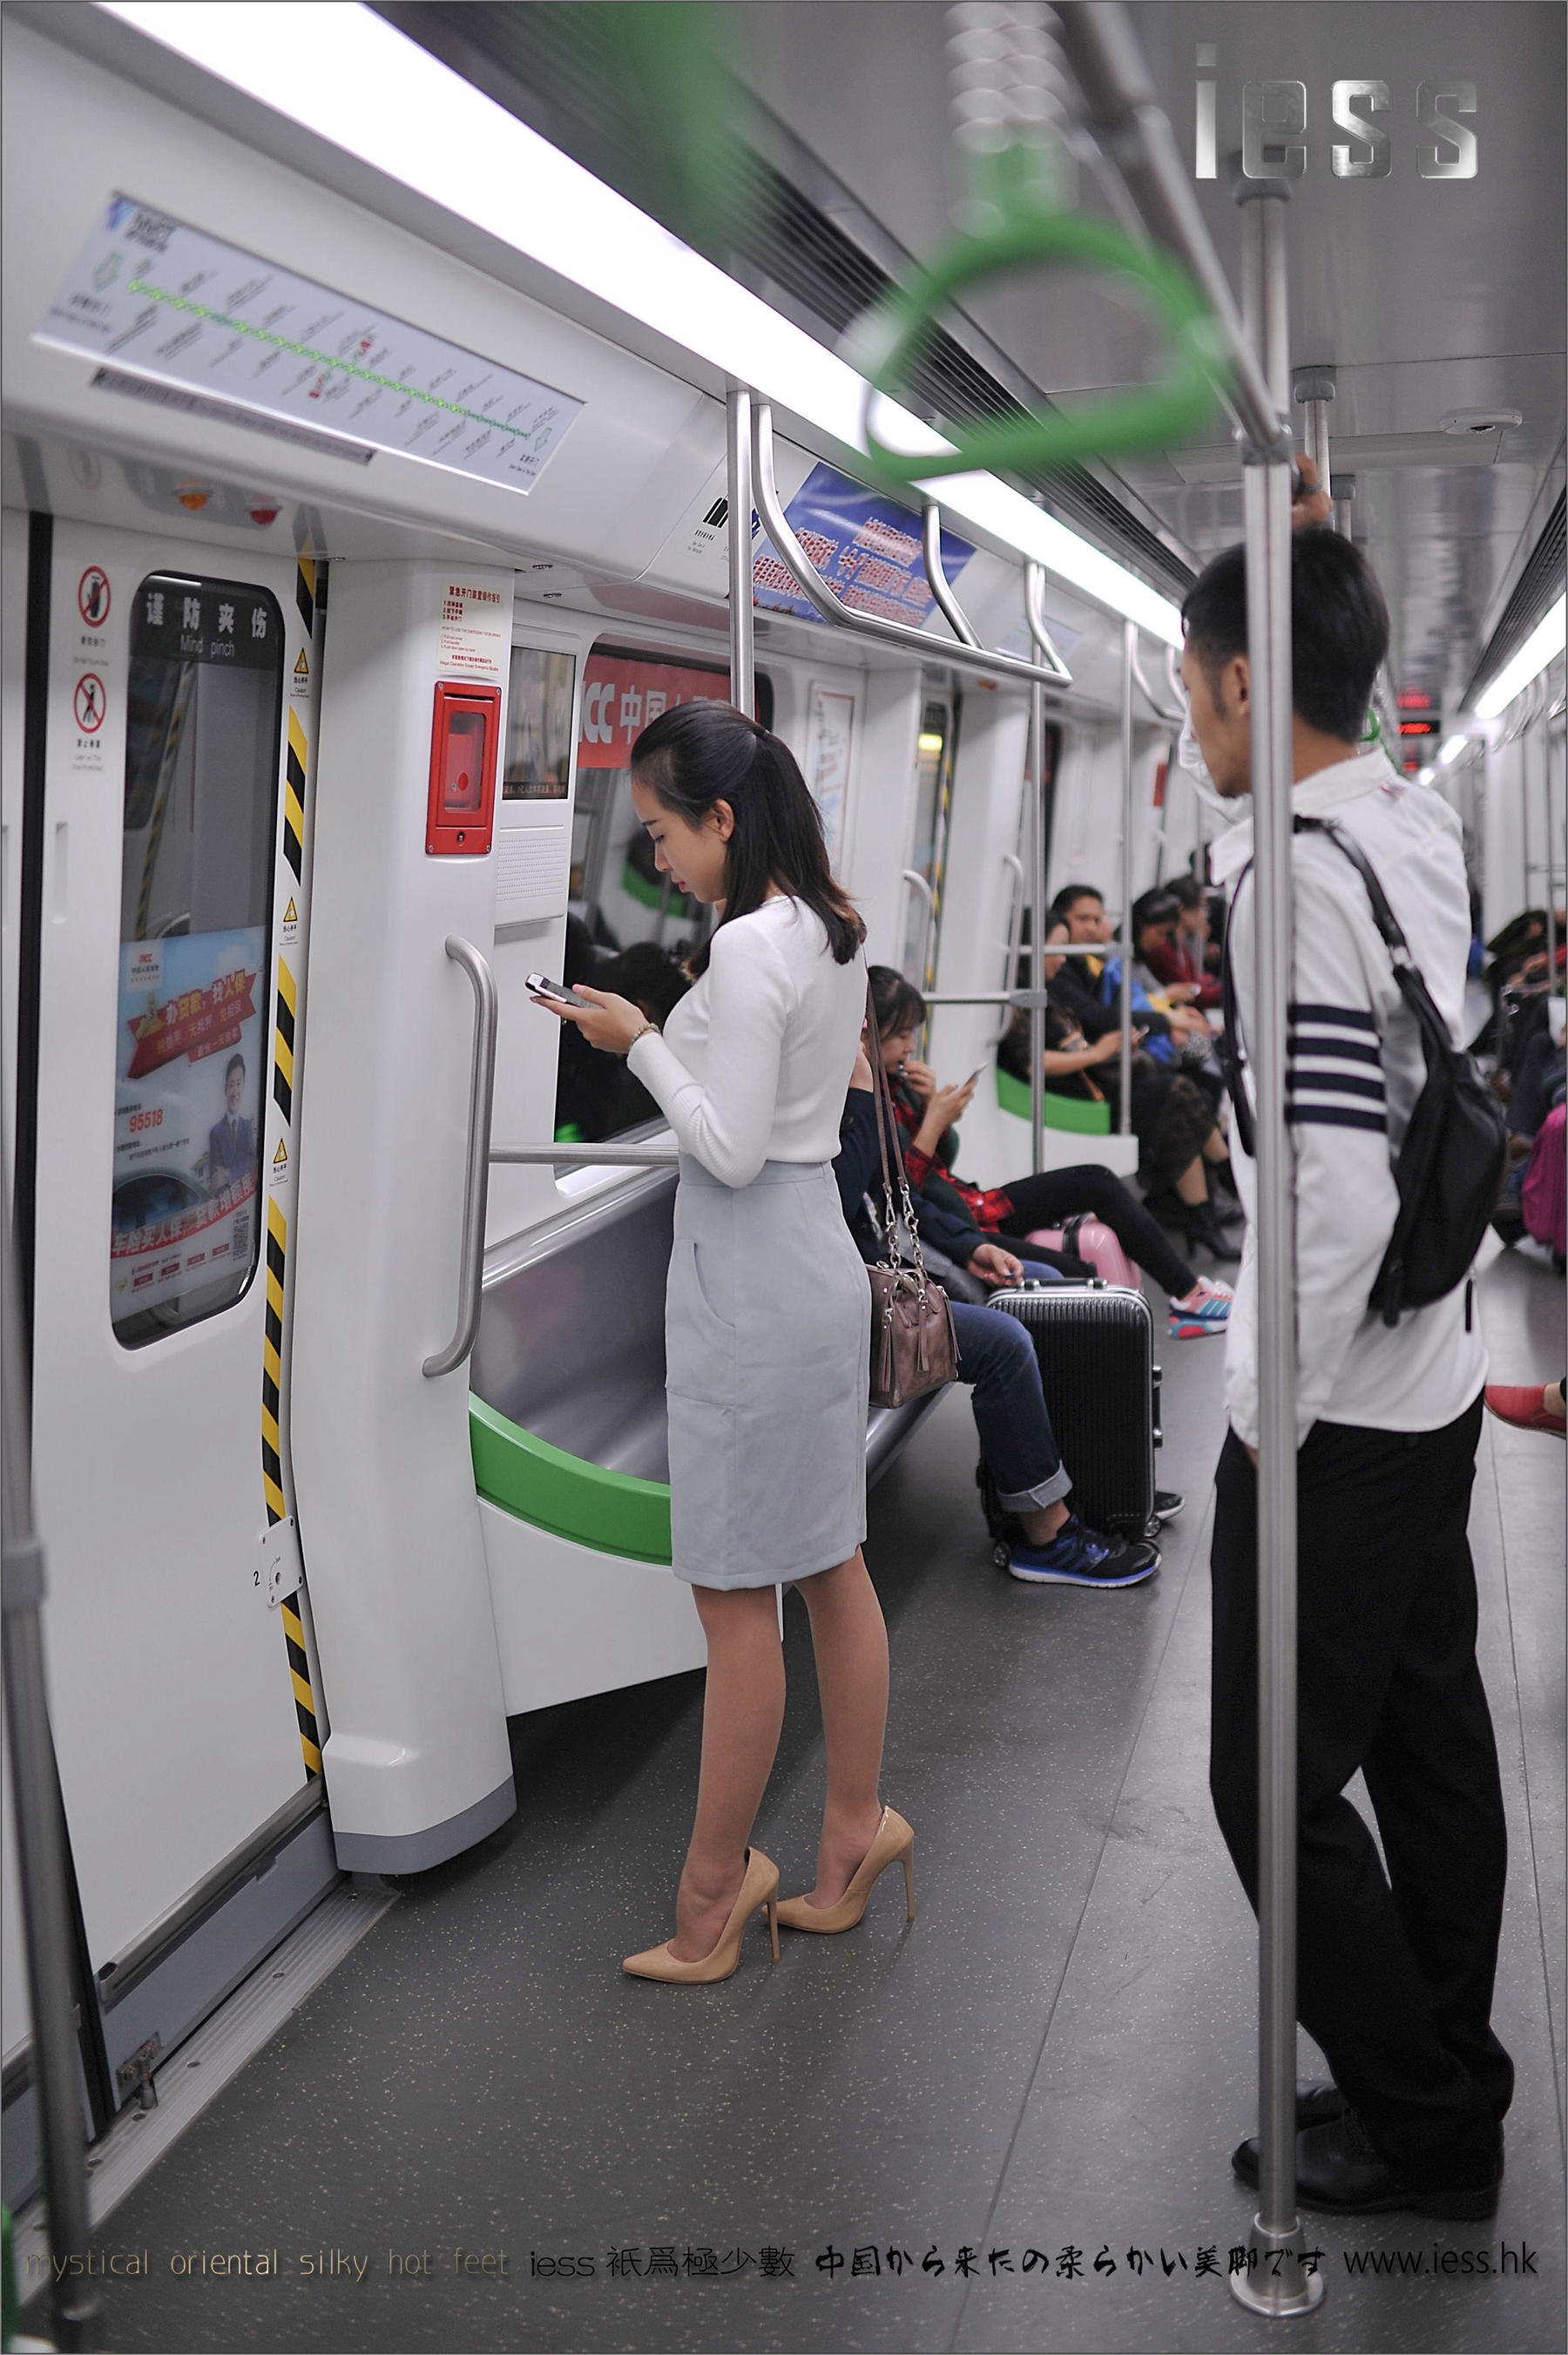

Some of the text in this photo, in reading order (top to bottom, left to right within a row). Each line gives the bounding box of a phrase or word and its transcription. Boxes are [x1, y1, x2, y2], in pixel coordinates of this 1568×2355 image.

[146, 592, 267, 639] 谨防夹伤
[179, 634, 235, 659] Mind pinch
[129, 1108, 164, 1133] 95518
[253, 1571, 260, 1587] 2
